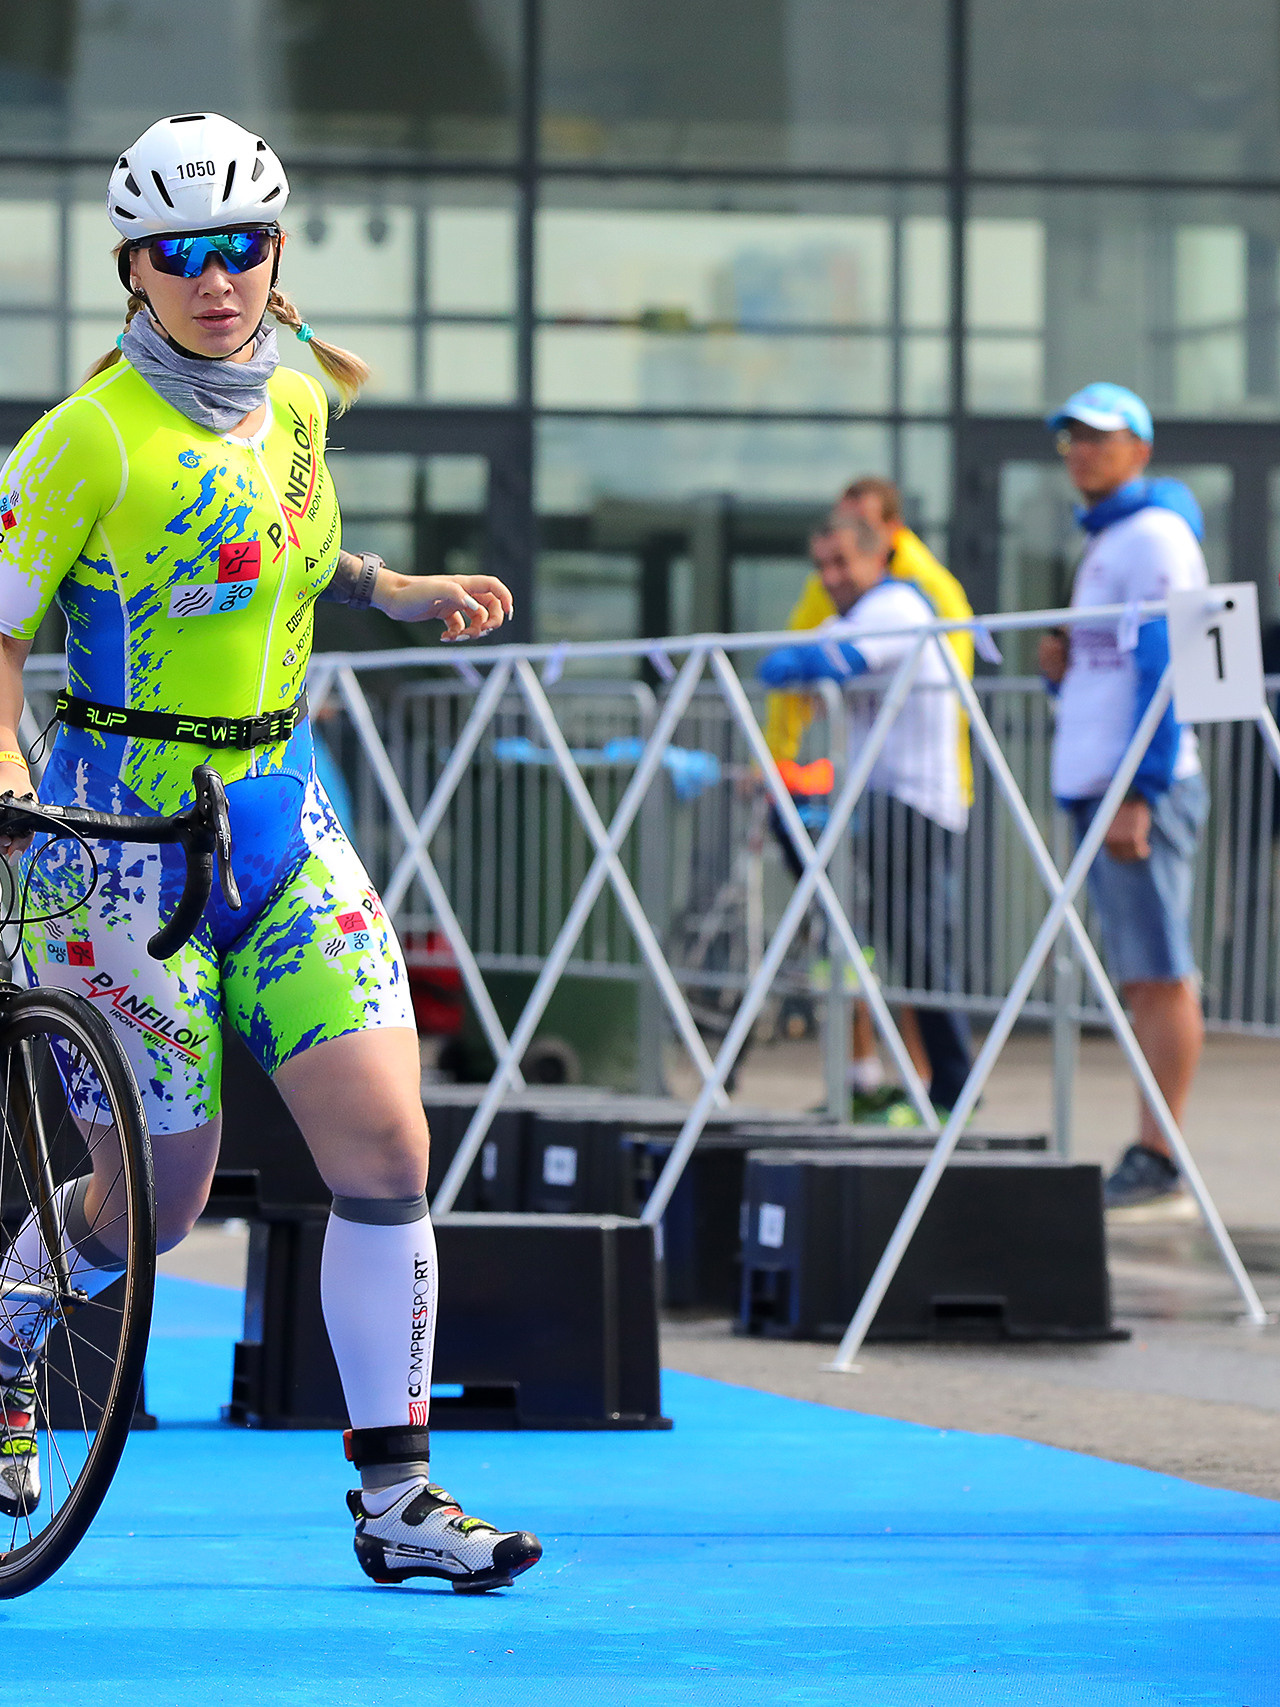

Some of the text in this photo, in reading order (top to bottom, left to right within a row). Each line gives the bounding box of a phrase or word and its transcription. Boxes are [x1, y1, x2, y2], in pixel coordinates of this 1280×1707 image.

[176, 160, 216, 180] 1050
[267, 403, 313, 549] PANFILOV
[307, 494, 322, 522] IRON
[1206, 627, 1224, 679] 1
[87, 972, 209, 1049] PANFILOV
[109, 1009, 197, 1067] IRON WILL TEAM
